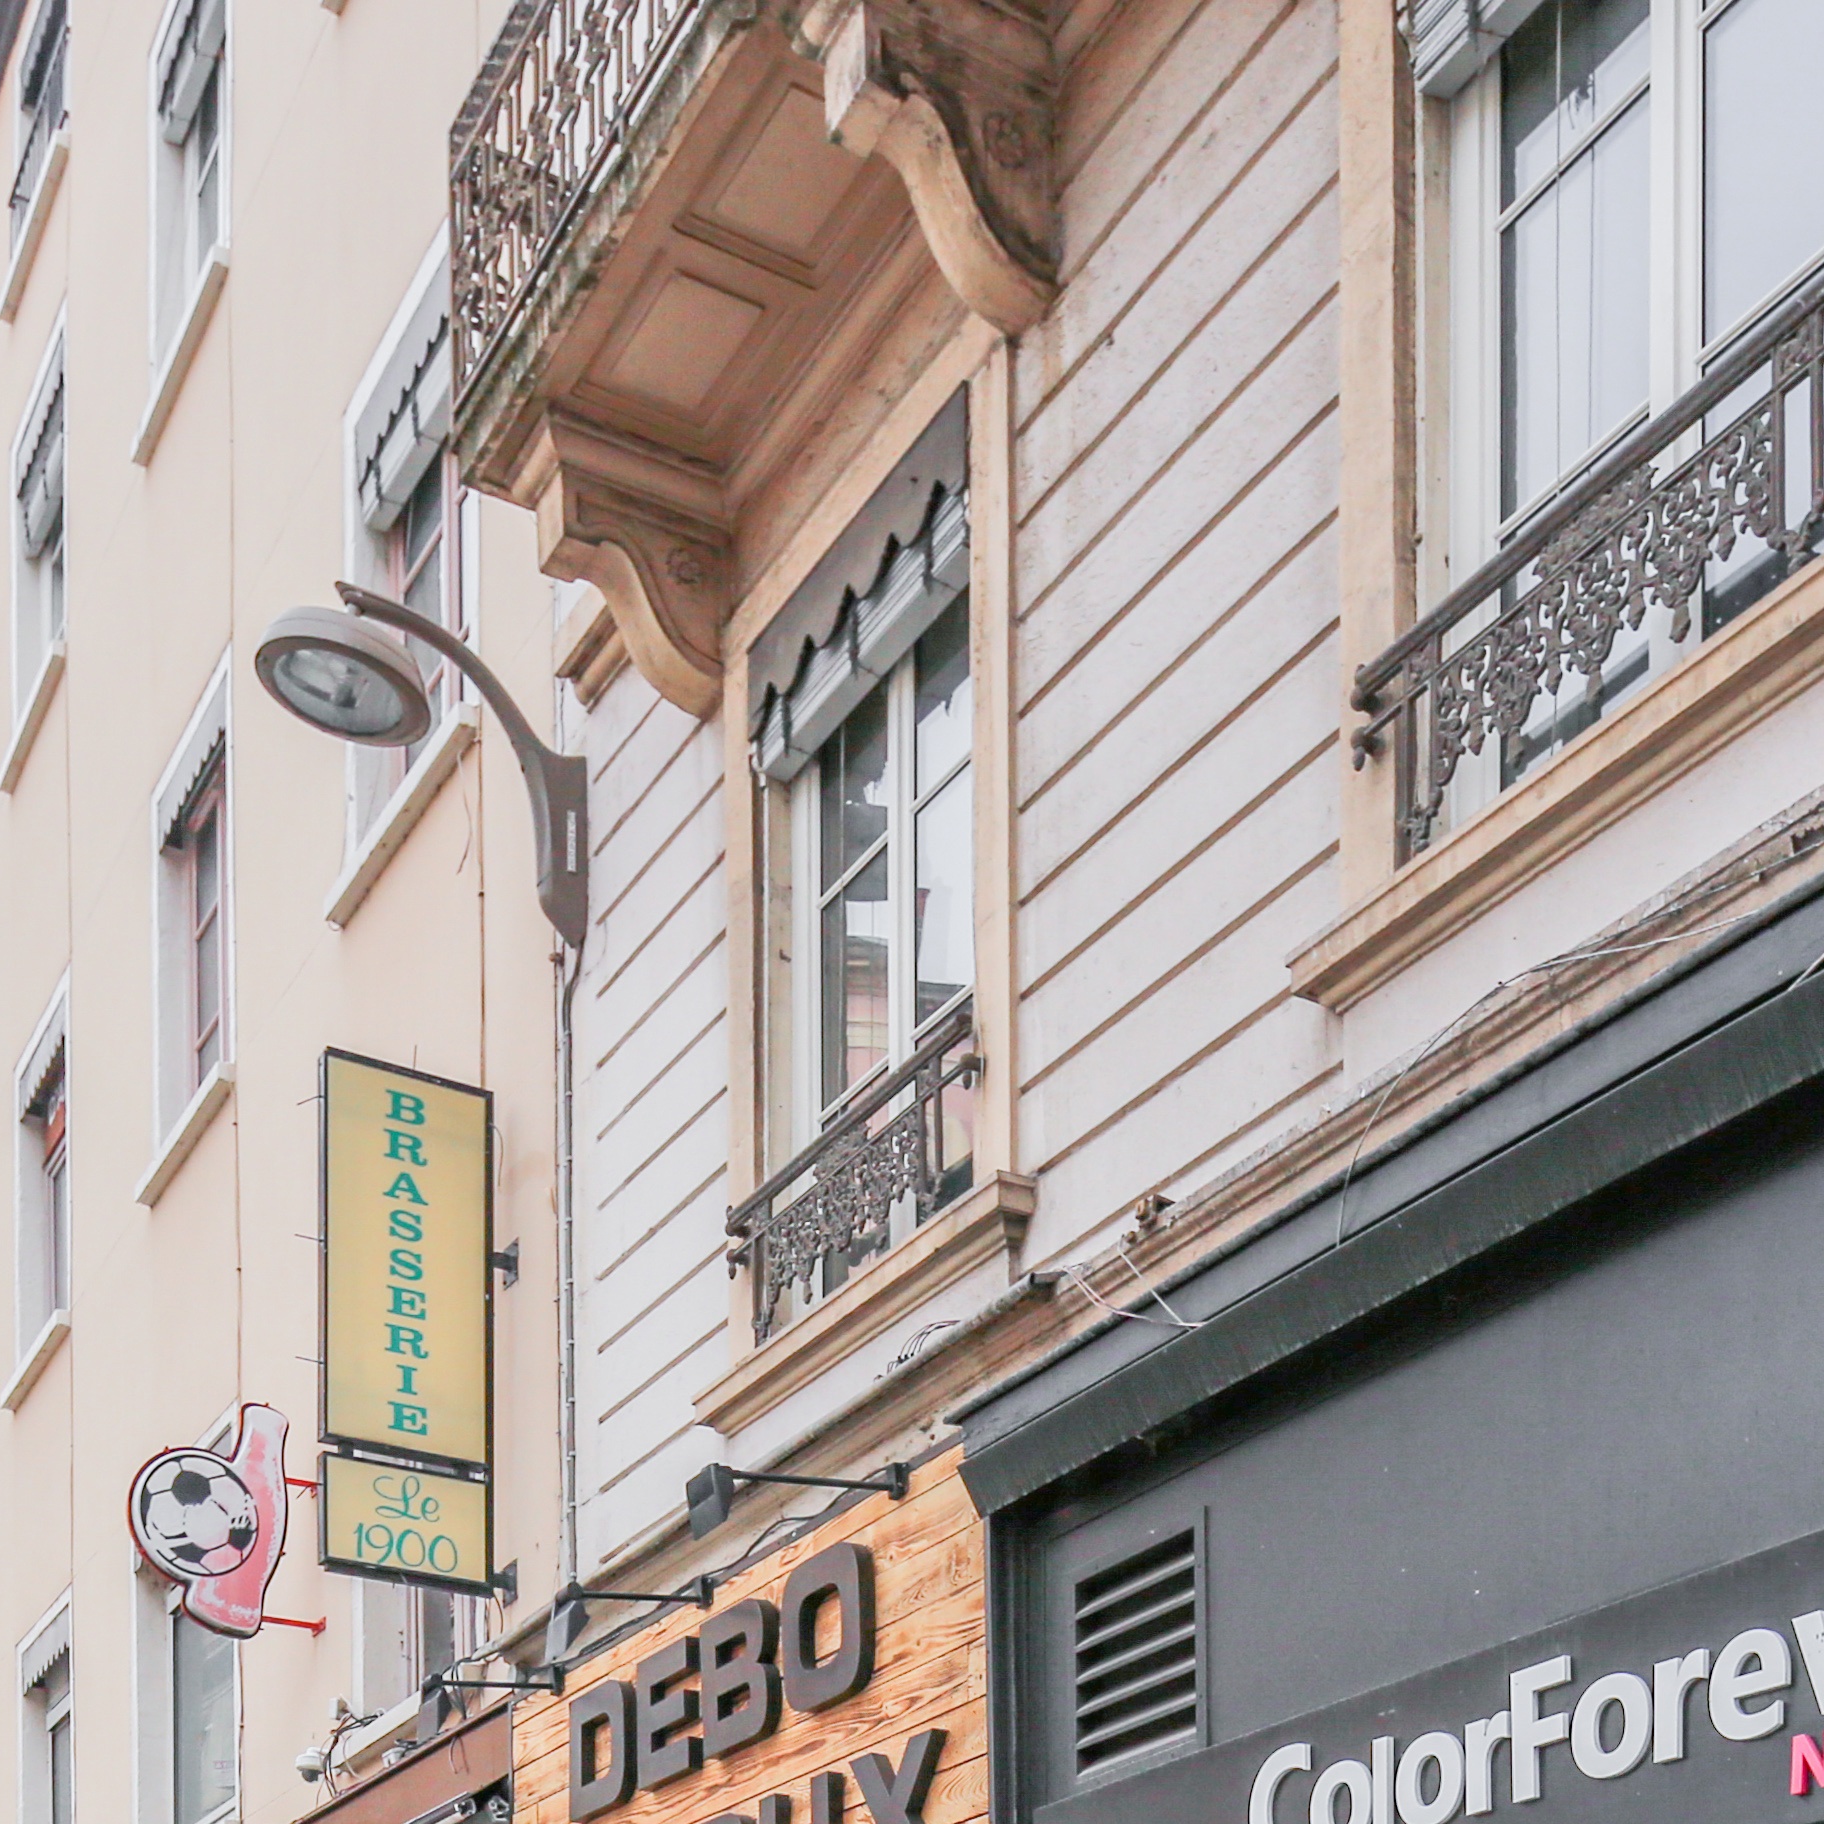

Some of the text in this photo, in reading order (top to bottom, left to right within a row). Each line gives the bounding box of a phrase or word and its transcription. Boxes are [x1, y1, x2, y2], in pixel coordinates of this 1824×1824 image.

[382, 1088, 429, 1437] BRASSERIE
[353, 1522, 459, 1574] 1900
[373, 1474, 440, 1523] Le
[569, 1541, 876, 1824] DEBO
